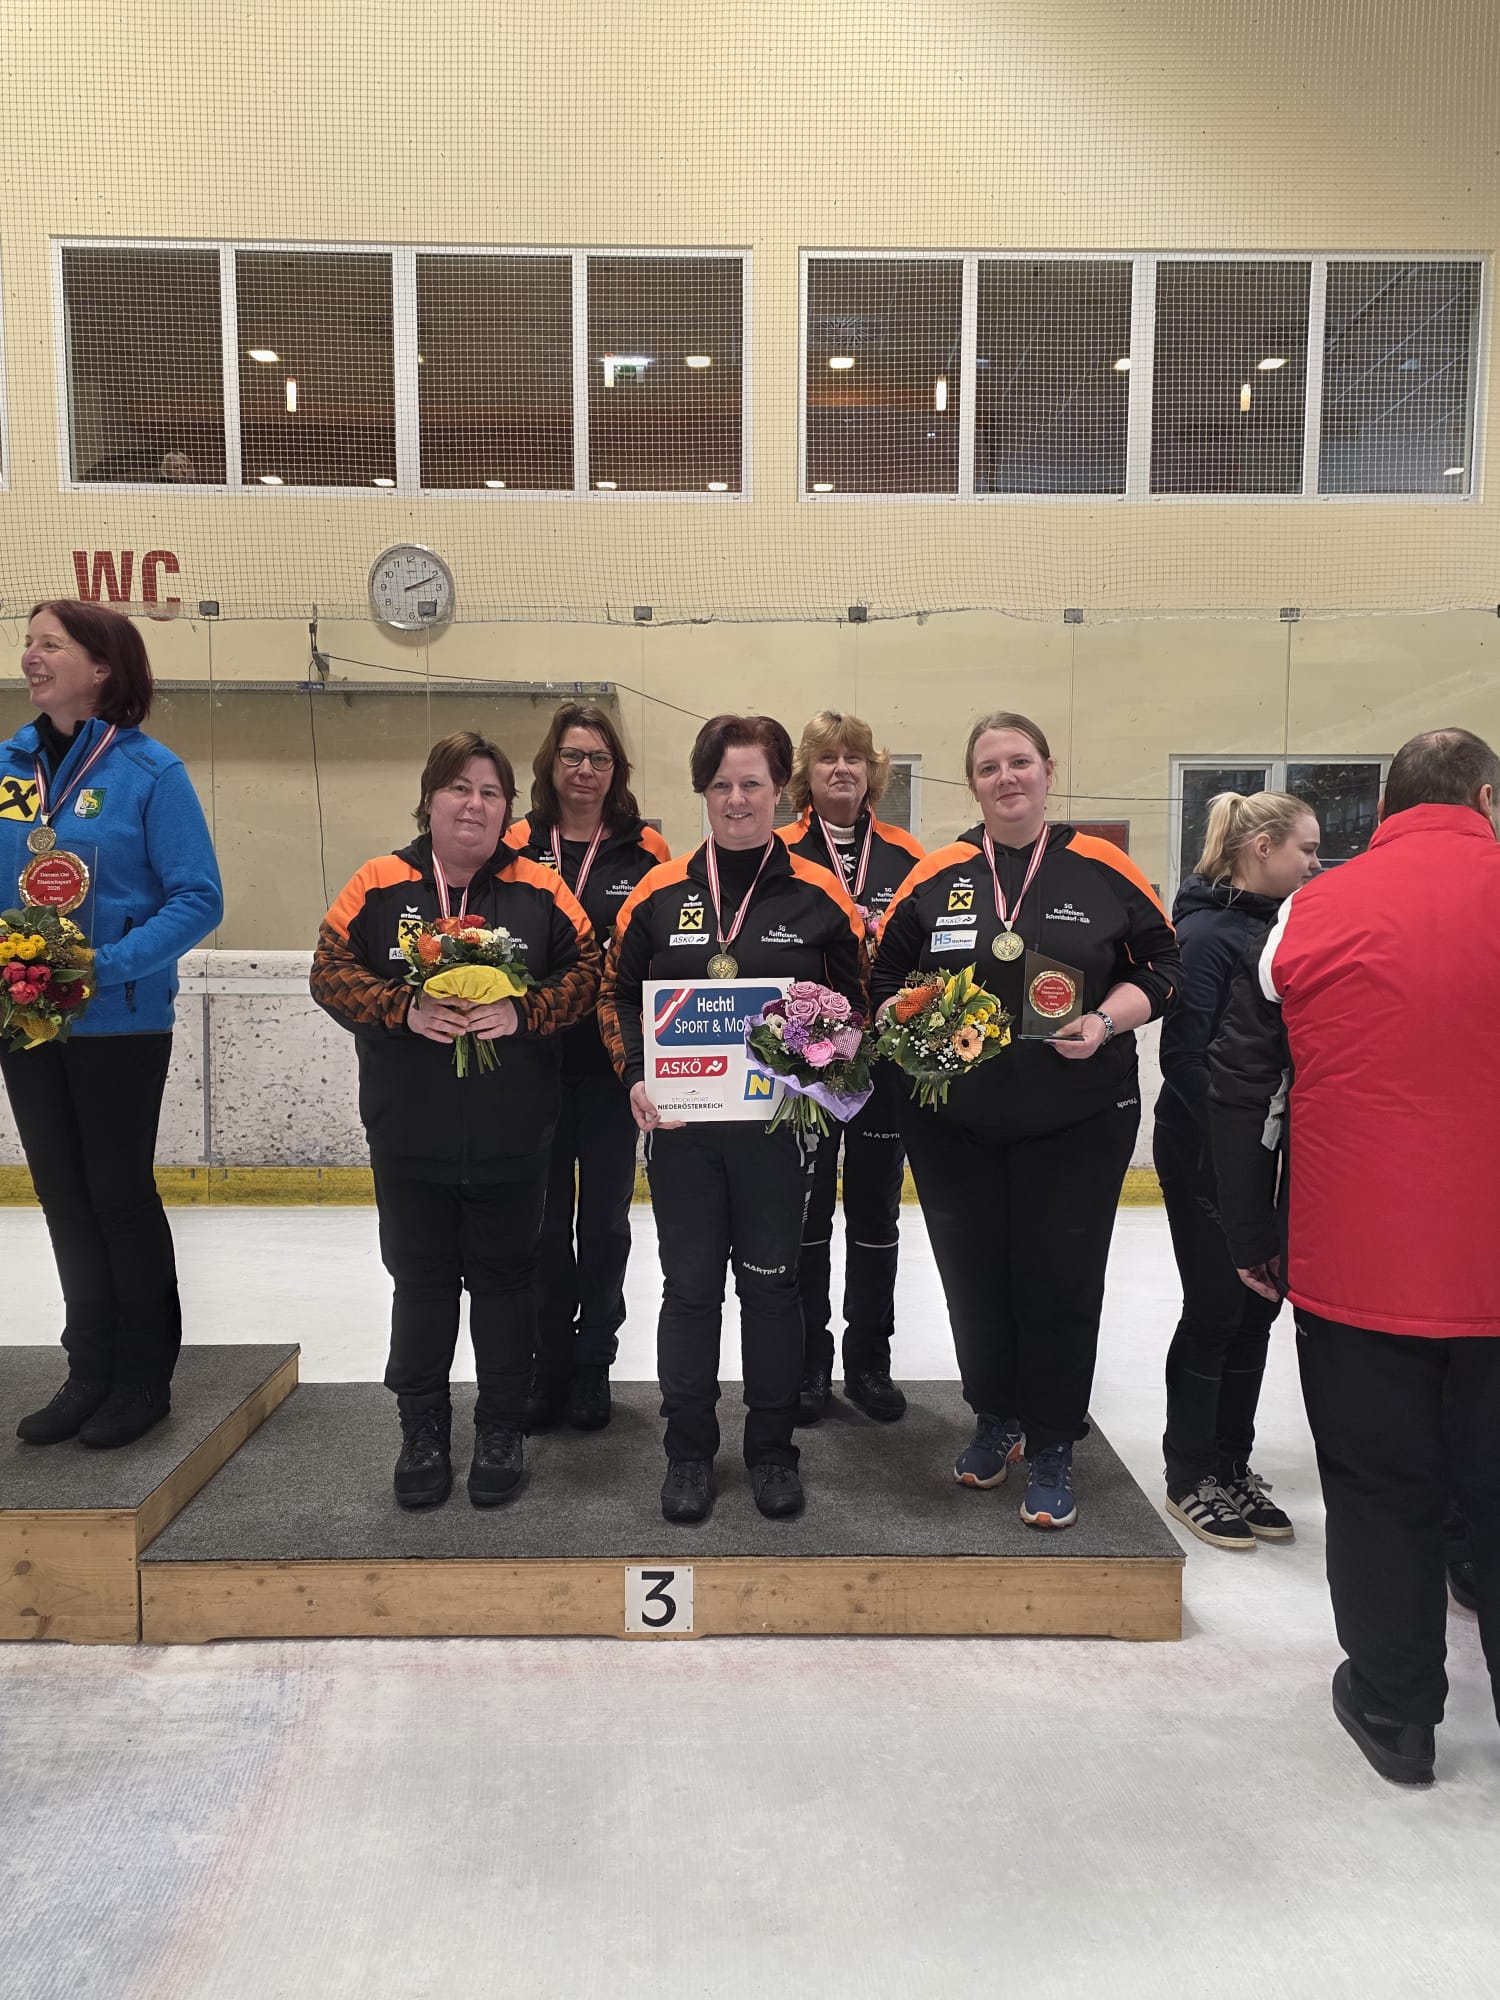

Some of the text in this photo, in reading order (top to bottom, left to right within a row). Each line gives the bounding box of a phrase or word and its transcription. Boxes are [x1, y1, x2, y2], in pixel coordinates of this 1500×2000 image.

[432, 570, 439, 578] 2
[72, 549, 180, 621] WC
[380, 583, 387, 591] 9
[385, 598, 392, 606] 8
[409, 612, 416, 620] 6
[934, 933, 952, 946] HS
[697, 996, 735, 1013] Hechtl
[712, 1019, 721, 1033] &
[660, 1058, 702, 1075] ASKÖ
[657, 1102, 723, 1111] NIEDERÖSTERREICH
[742, 1261, 777, 1275] MARTINI
[641, 1571, 677, 1627] 3
